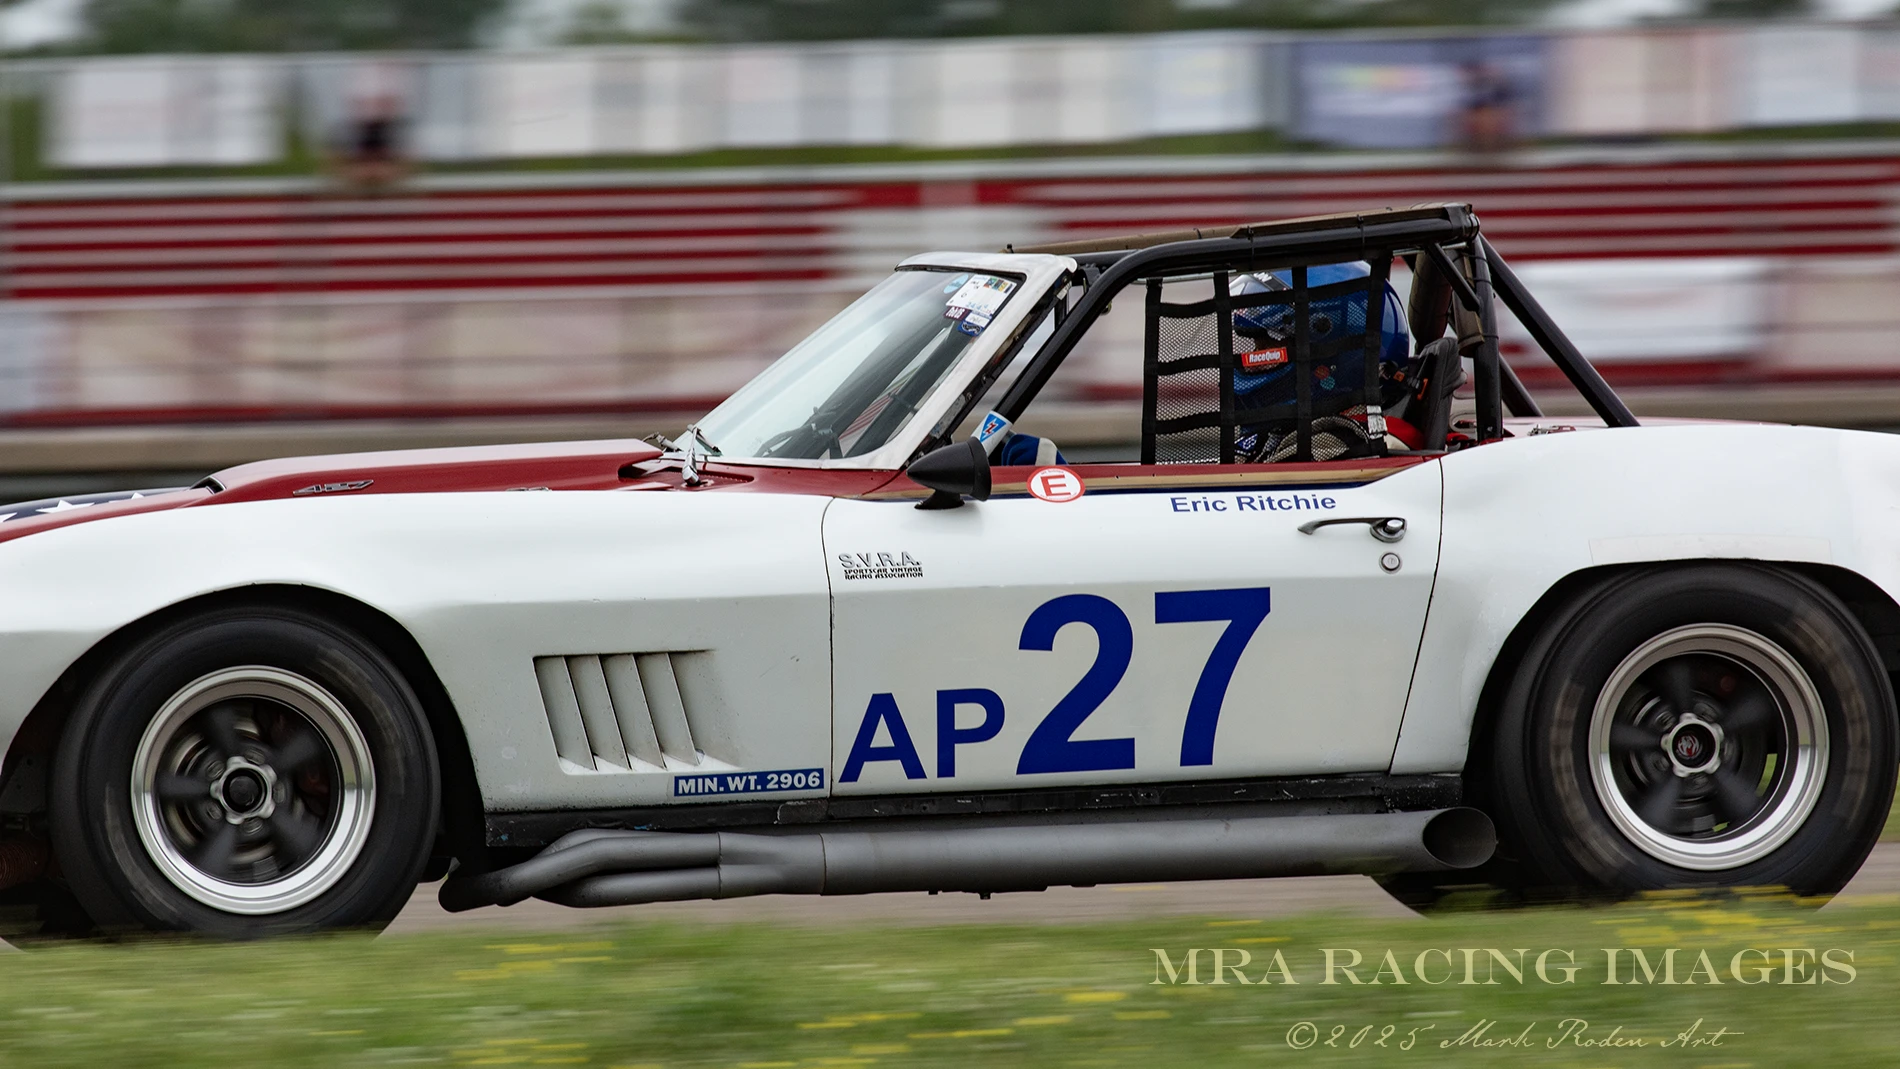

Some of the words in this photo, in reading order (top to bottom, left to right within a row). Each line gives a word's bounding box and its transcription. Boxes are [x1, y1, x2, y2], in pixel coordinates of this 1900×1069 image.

[1249, 351, 1281, 363] RaceQuip
[1040, 474, 1071, 497] E
[1170, 496, 1228, 513] Eric
[1236, 494, 1337, 512] Ritchie
[838, 551, 922, 568] S.V.R.A.
[838, 688, 1006, 783] AP
[1015, 587, 1271, 775] 27
[766, 771, 821, 789] 2906
